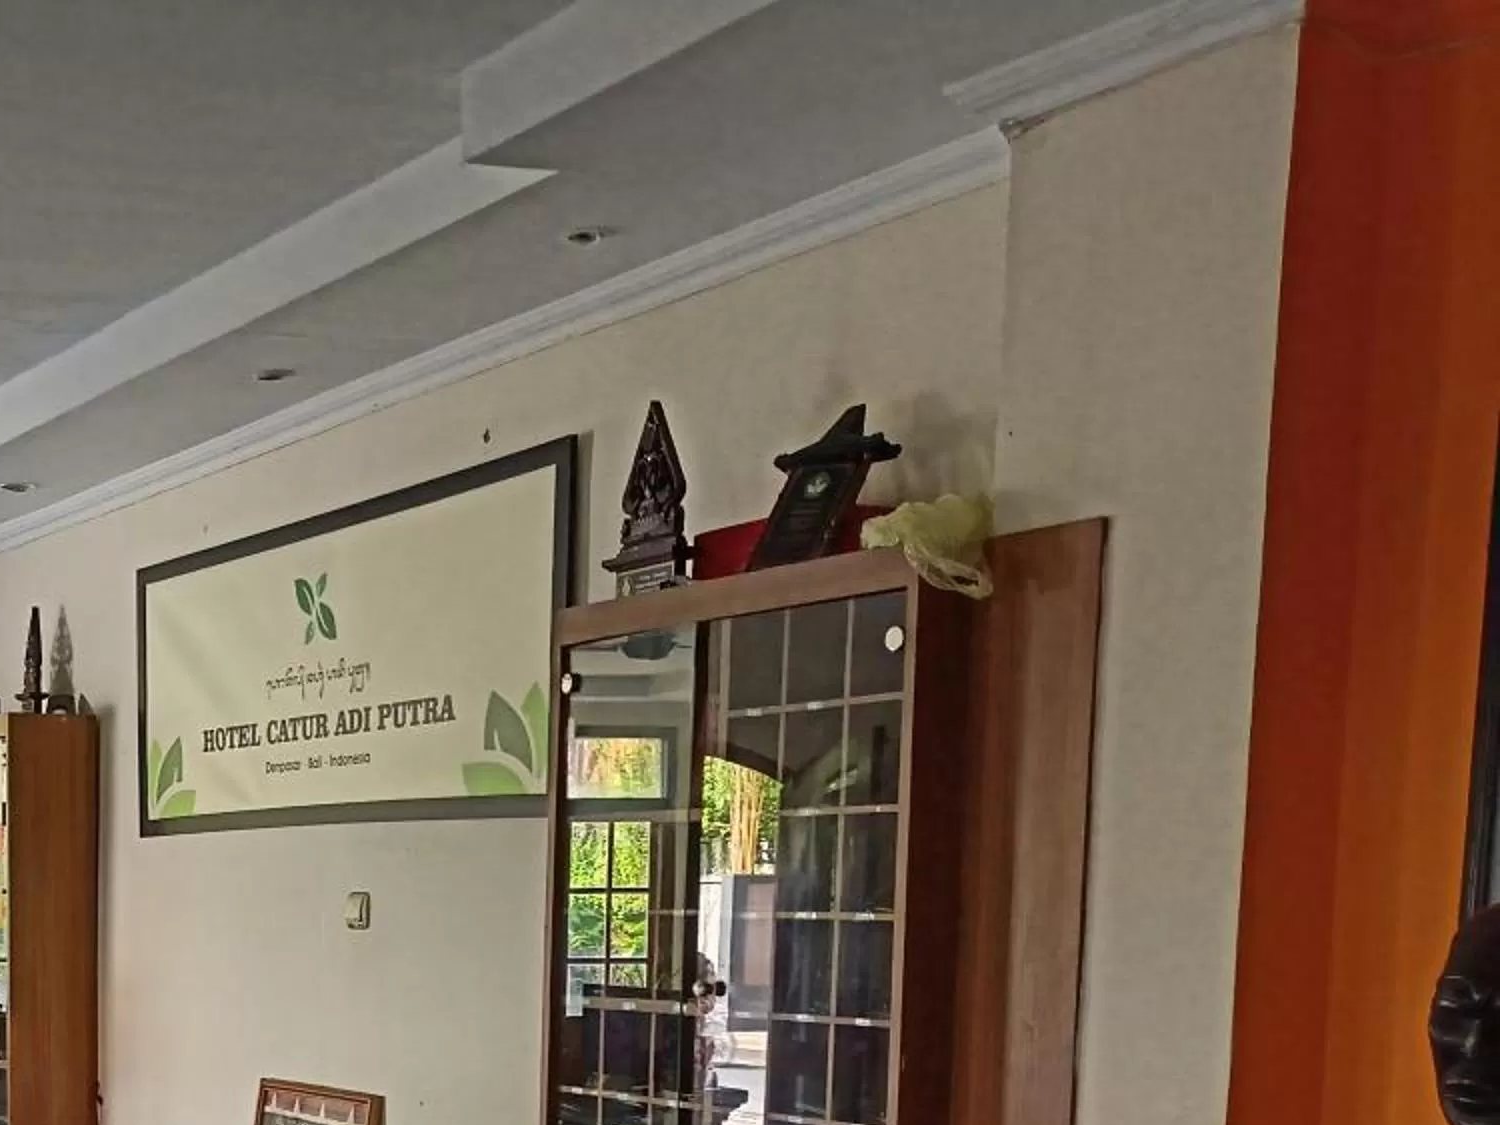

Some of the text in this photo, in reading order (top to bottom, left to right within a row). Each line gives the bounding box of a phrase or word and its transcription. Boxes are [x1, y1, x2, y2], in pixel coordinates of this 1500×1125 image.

[202, 694, 457, 753] HOTEL CATUR ADI PUTRA
[308, 755, 323, 769] Bali
[329, 752, 372, 768] Indonesia
